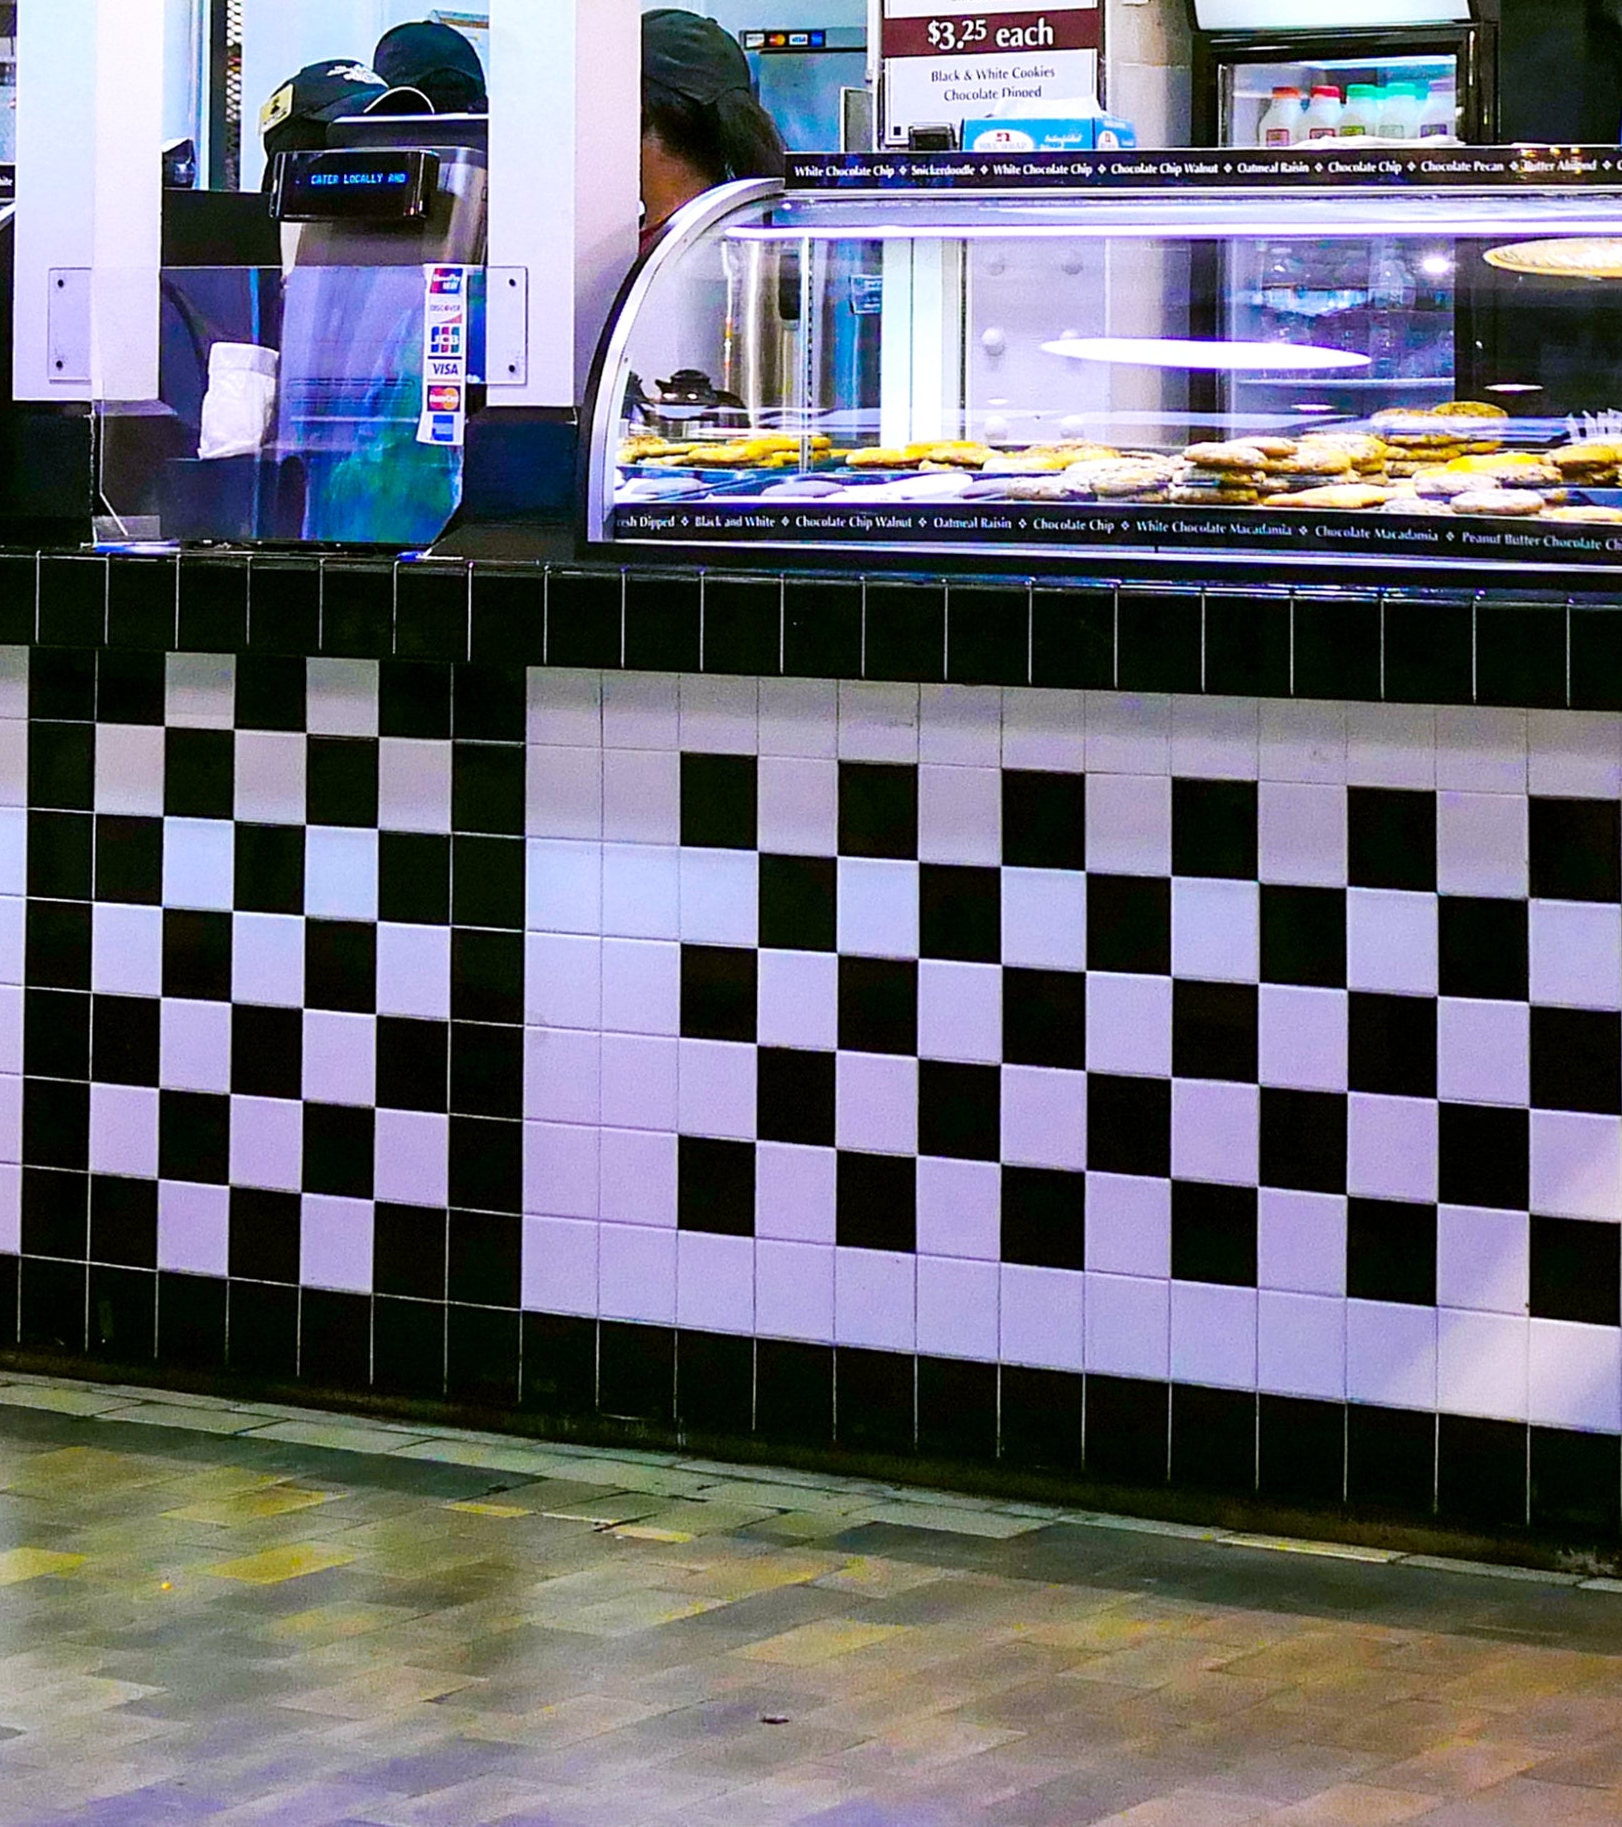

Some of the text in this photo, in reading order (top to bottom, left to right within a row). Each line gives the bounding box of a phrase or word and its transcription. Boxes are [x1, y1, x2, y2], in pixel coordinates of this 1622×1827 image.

[928, 16, 1054, 50] $3.25 each
[931, 66, 1056, 83] Black & White Cookies
[944, 88, 999, 102] Chocolate
[794, 160, 1402, 178] White Chocolate Chip Snickerdoodle White Chocolate Chip Chocolate Chip Walnut Oatmeal Raisin Chocolate Chip
[311, 174, 339, 185] CATER
[344, 173, 383, 184] LOCALLY
[431, 334, 460, 346] JCB
[432, 363, 459, 375] VISA
[640, 515, 675, 531] Dipped
[695, 515, 722, 527] Black
[725, 515, 742, 527] and
[745, 515, 776, 528] White
[795, 515, 846, 528] Chocolate
[849, 516, 873, 532] Chip
[876, 516, 912, 528] Walnut
[934, 517, 978, 529] Oatmeal
[981, 517, 1012, 529] Raisin
[1033, 517, 1086, 530] Chocolate
[1088, 517, 1115, 534] Chip
[1137, 520, 1168, 532] White
[1171, 520, 1227, 534] Chocolate
[1230, 522, 1292, 536] Macadamia
[1462, 530, 1501, 544] Peanut
[1504, 532, 1540, 546] Butter
[1543, 534, 1602, 550] Chocolate
